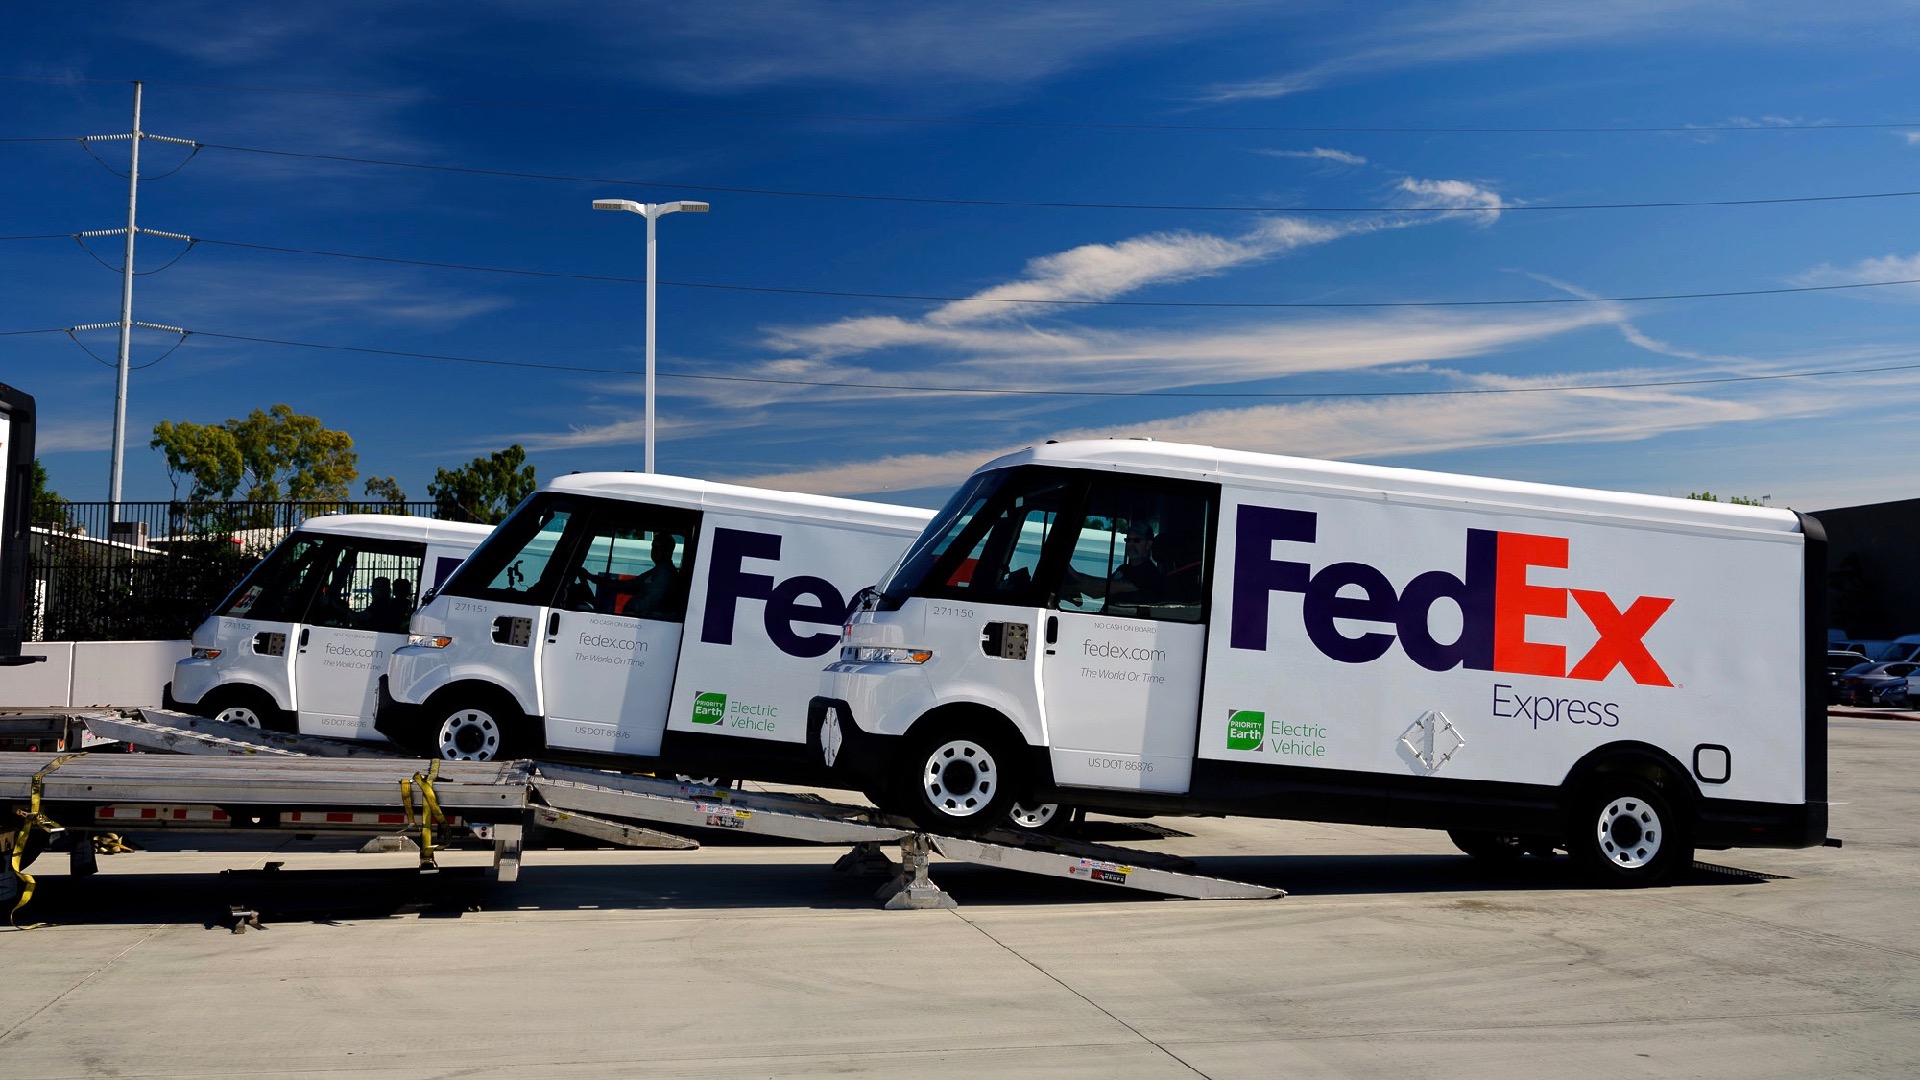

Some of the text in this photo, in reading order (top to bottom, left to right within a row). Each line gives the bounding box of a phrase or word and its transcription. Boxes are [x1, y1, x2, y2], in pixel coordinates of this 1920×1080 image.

[1230, 503, 1675, 688] FedEx
[455, 603, 488, 613] 271151
[933, 606, 974, 618] 271150
[1134, 626, 1157, 634] BOARD
[579, 632, 648, 652] fedex.com
[1083, 638, 1166, 661] fedex.com
[325, 642, 383, 659] fedex.com
[323, 659, 335, 667] The
[335, 660, 355, 669] World
[355, 661, 365, 669] On
[1081, 667, 1097, 678] The
[1098, 669, 1126, 681] World
[1142, 672, 1165, 684] Time
[695, 706, 722, 716] Earth
[696, 700, 724, 708] PRIORITY
[730, 701, 778, 717] Electric
[1493, 683, 1620, 730] Express
[321, 718, 331, 726] US
[331, 719, 346, 727] DOT
[730, 715, 775, 732] Vehicle
[1230, 720, 1262, 729] PRIORITY
[1271, 720, 1327, 739] Electric
[575, 726, 587, 734] US
[587, 727, 606, 736] DOT
[1230, 728, 1262, 740] Earth
[1271, 738, 1326, 757] Vehicle
[1088, 757, 1154, 773] US DOT 86876
